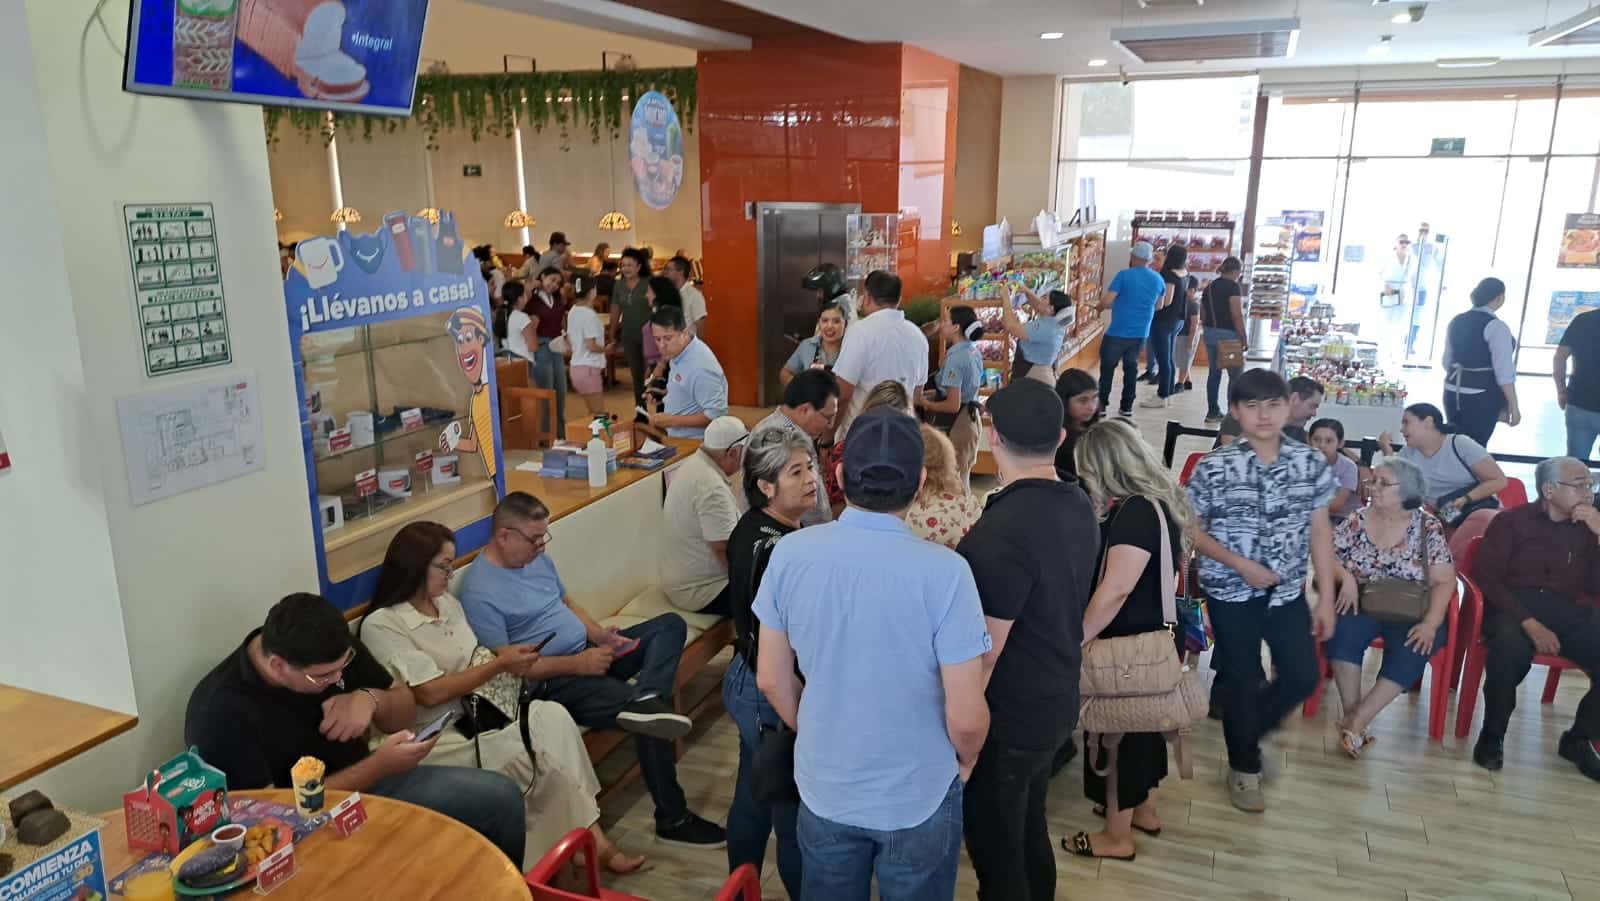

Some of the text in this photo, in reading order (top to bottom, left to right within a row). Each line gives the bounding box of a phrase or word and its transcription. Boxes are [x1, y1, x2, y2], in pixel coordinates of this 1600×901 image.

[299, 276, 475, 332] ¡Llévanos a casa!
[0, 840, 93, 901] COMIENZA
